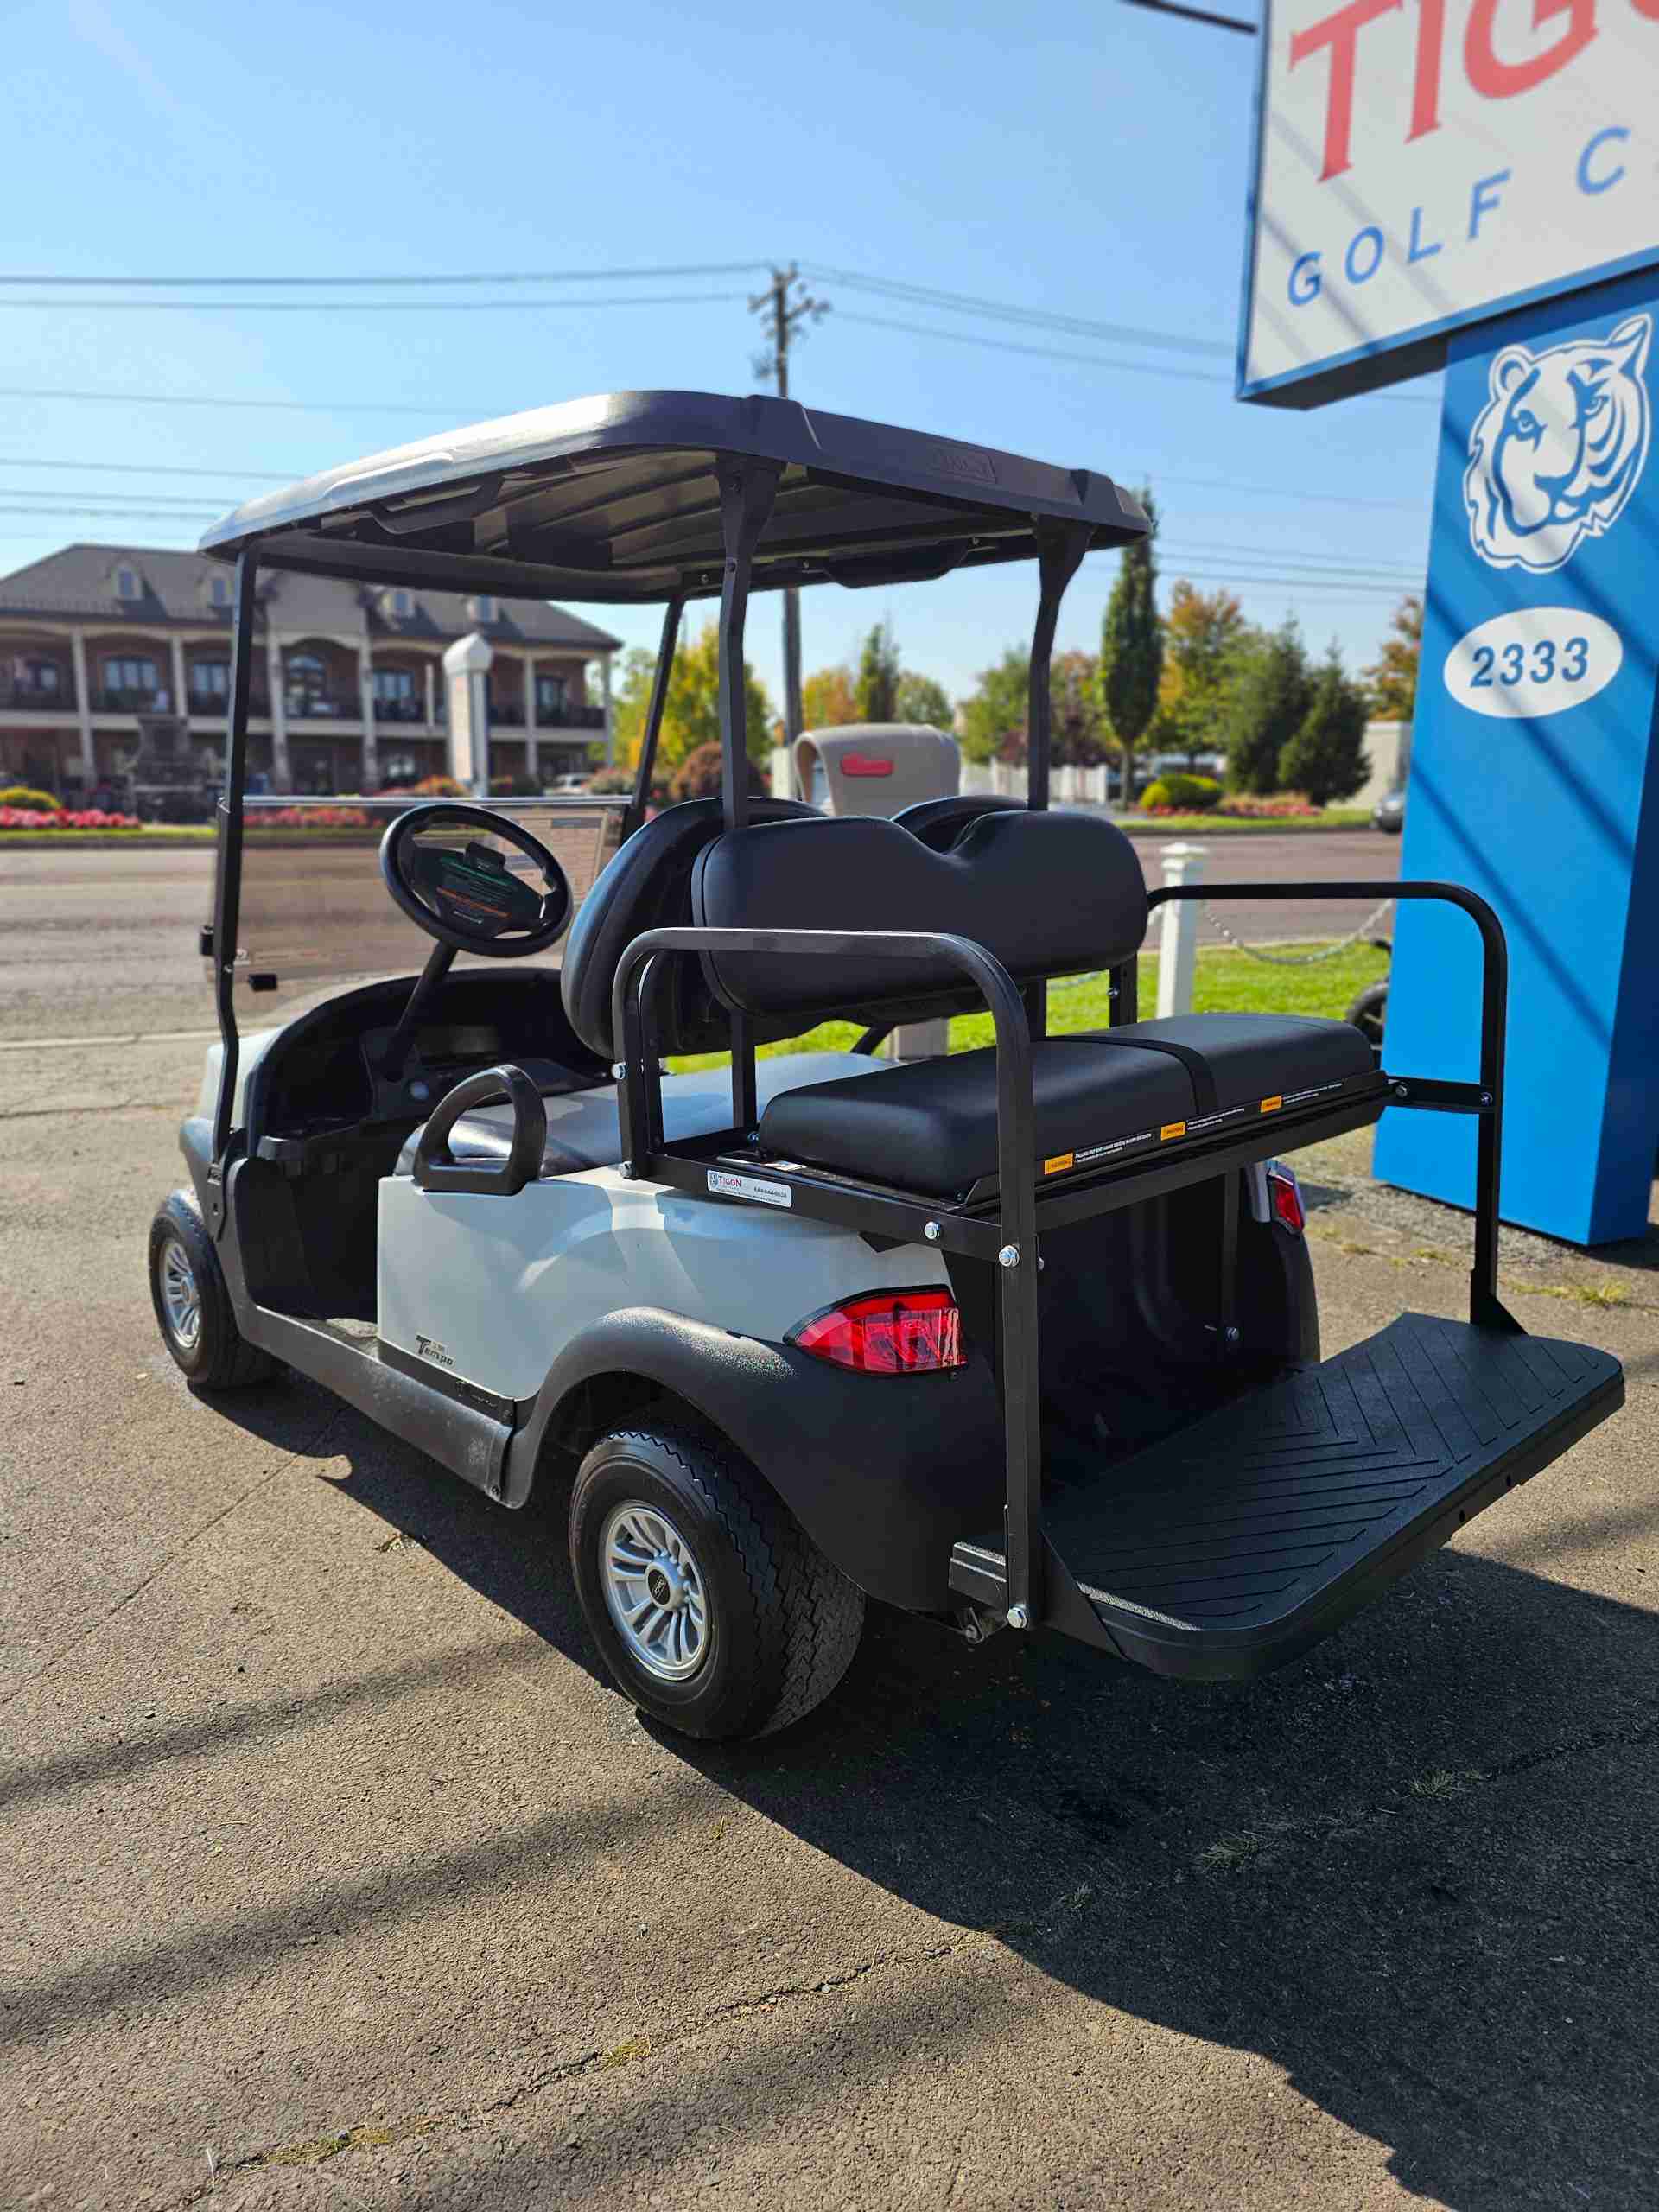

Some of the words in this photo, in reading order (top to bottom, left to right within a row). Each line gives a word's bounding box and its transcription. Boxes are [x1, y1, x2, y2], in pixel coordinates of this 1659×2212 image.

[1287, 0, 1659, 184] TIG
[1287, 168, 1511, 307] GOLF
[1470, 636, 1590, 688] 2333
[415, 1334, 454, 1366] Tempo
